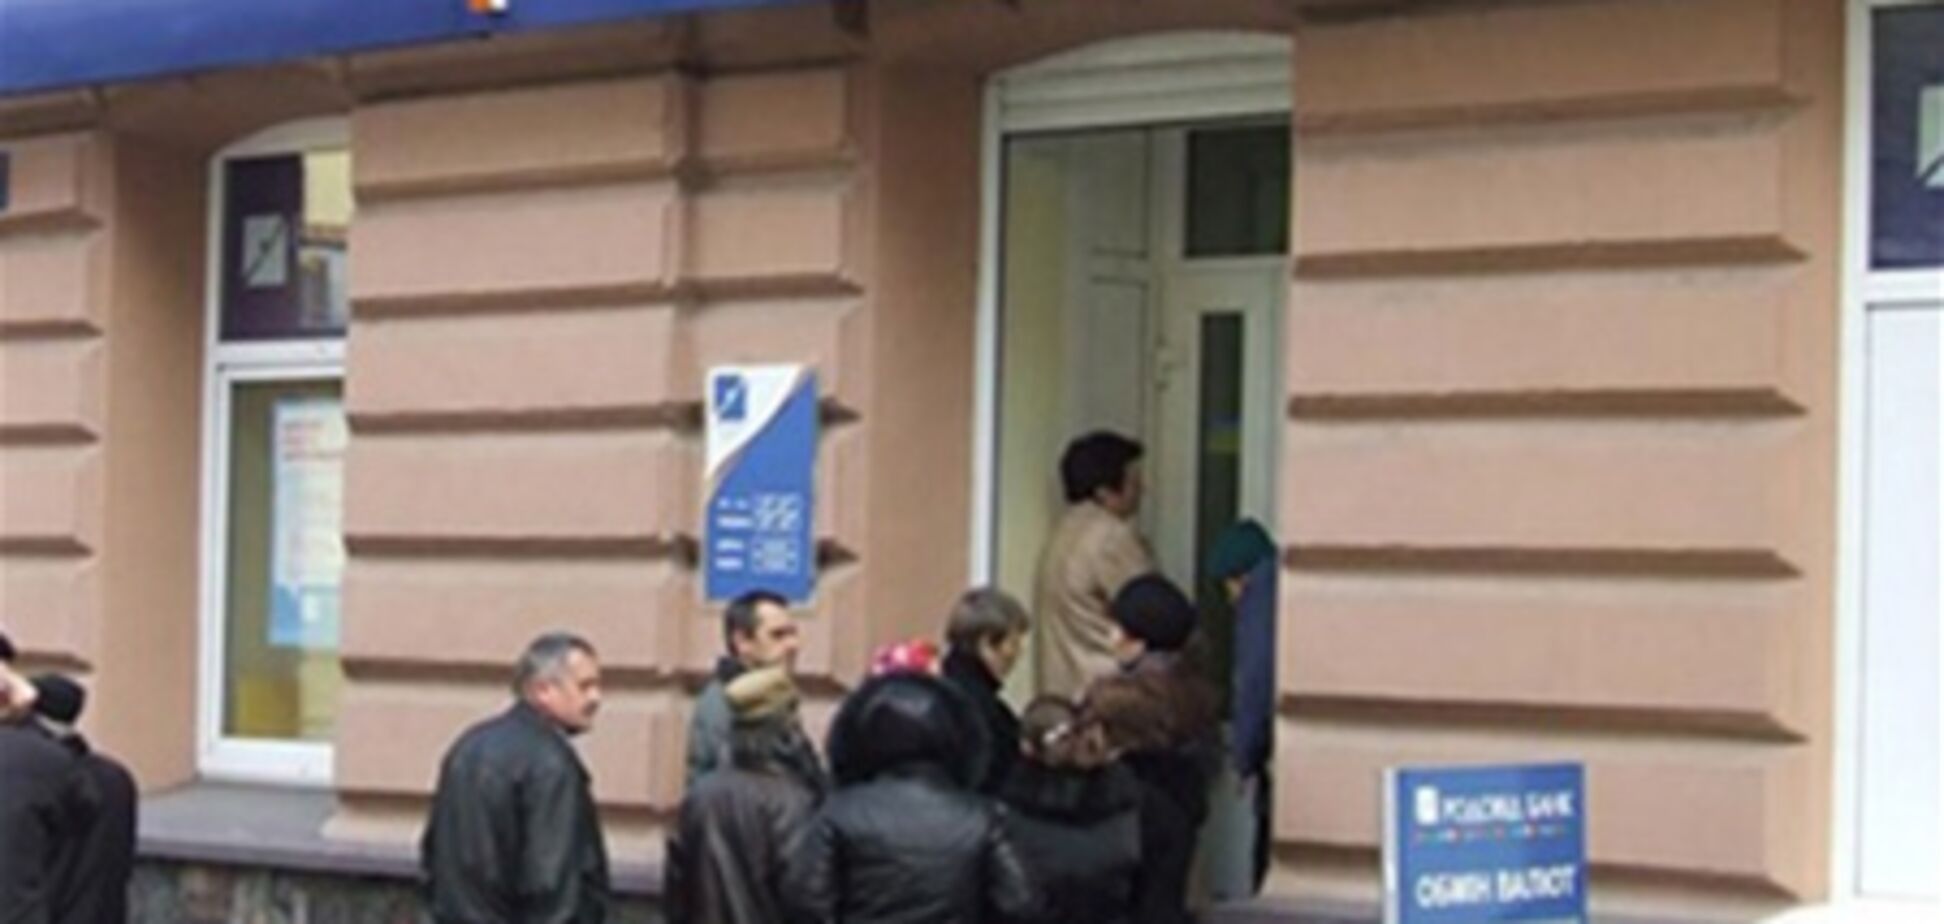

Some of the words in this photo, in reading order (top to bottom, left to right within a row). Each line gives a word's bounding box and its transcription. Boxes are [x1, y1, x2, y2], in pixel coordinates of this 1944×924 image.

[1525, 791, 1572, 818] БАНК
[1416, 873, 1491, 908] ОБМІН
[1498, 864, 1576, 903] ВАЛЮТ
